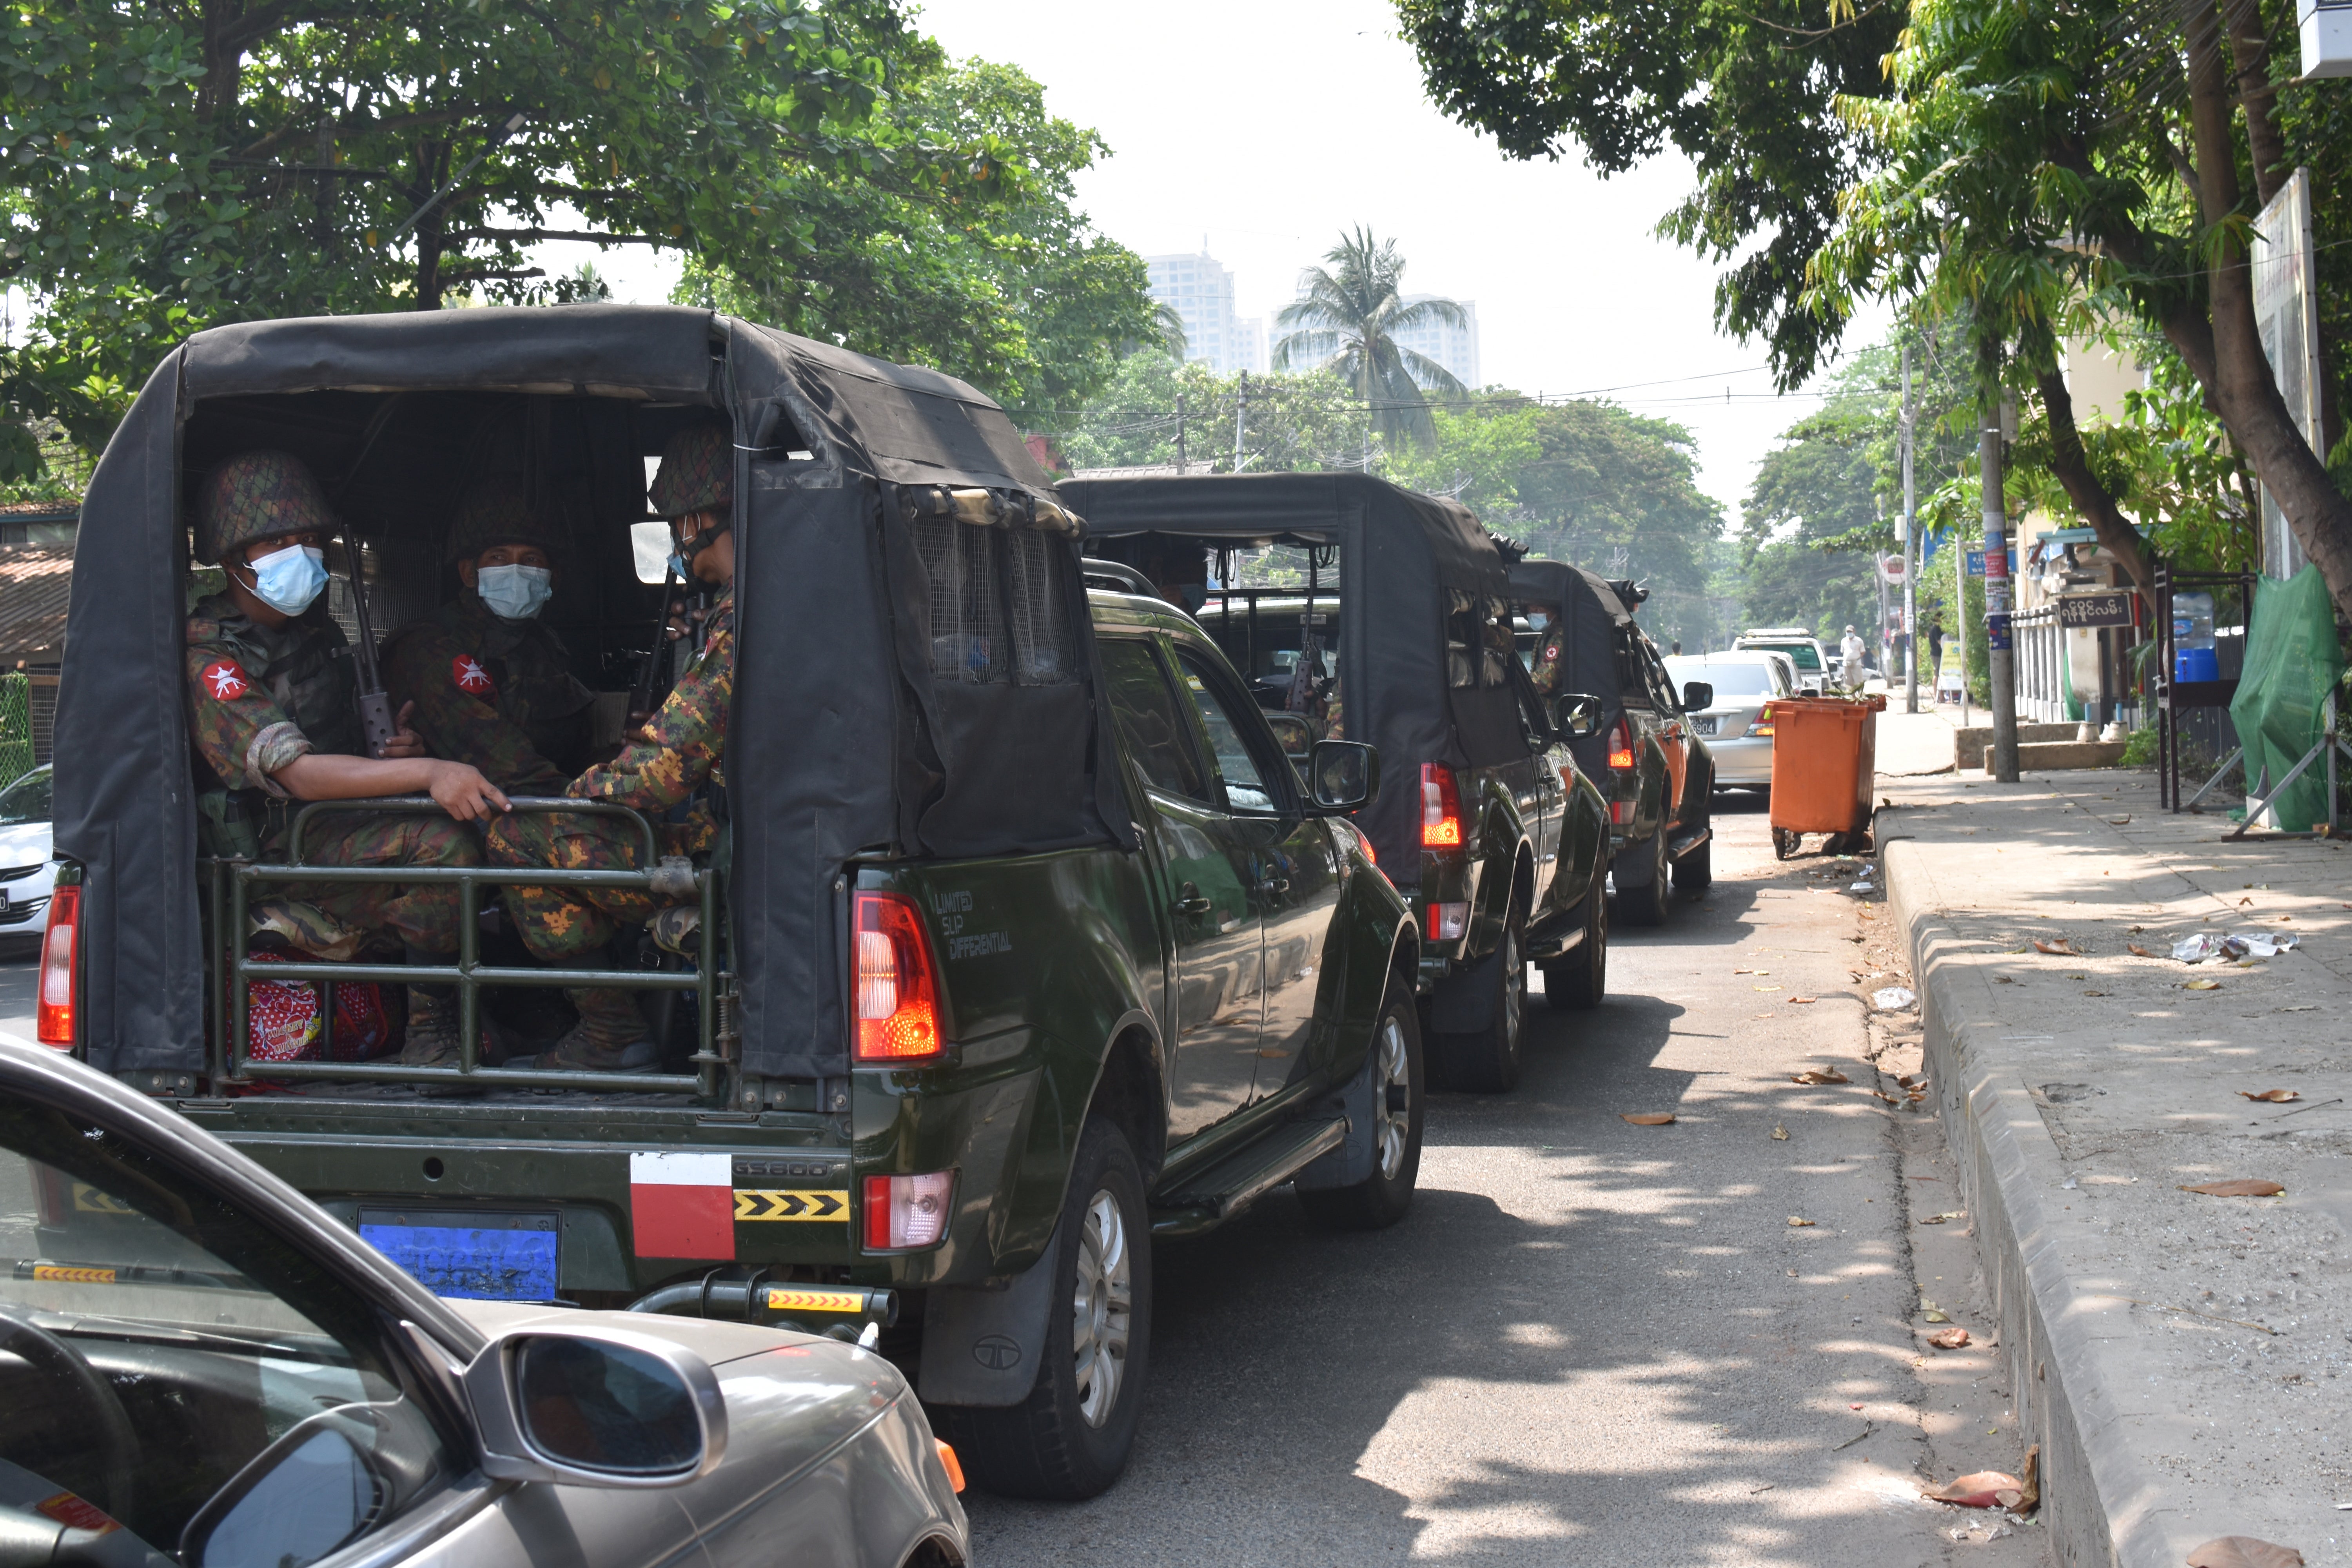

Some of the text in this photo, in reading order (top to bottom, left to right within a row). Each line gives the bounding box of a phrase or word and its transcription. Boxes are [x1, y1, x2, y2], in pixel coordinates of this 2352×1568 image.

[935, 890, 972, 915] LIMITED
[942, 915, 963, 936] SLIP
[949, 931, 1012, 960] DIFFERENTIAL
[267, 1018, 304, 1040] MICKEY
[274, 1035, 309, 1055] MINNIE
[732, 1161, 828, 1176] GS800
